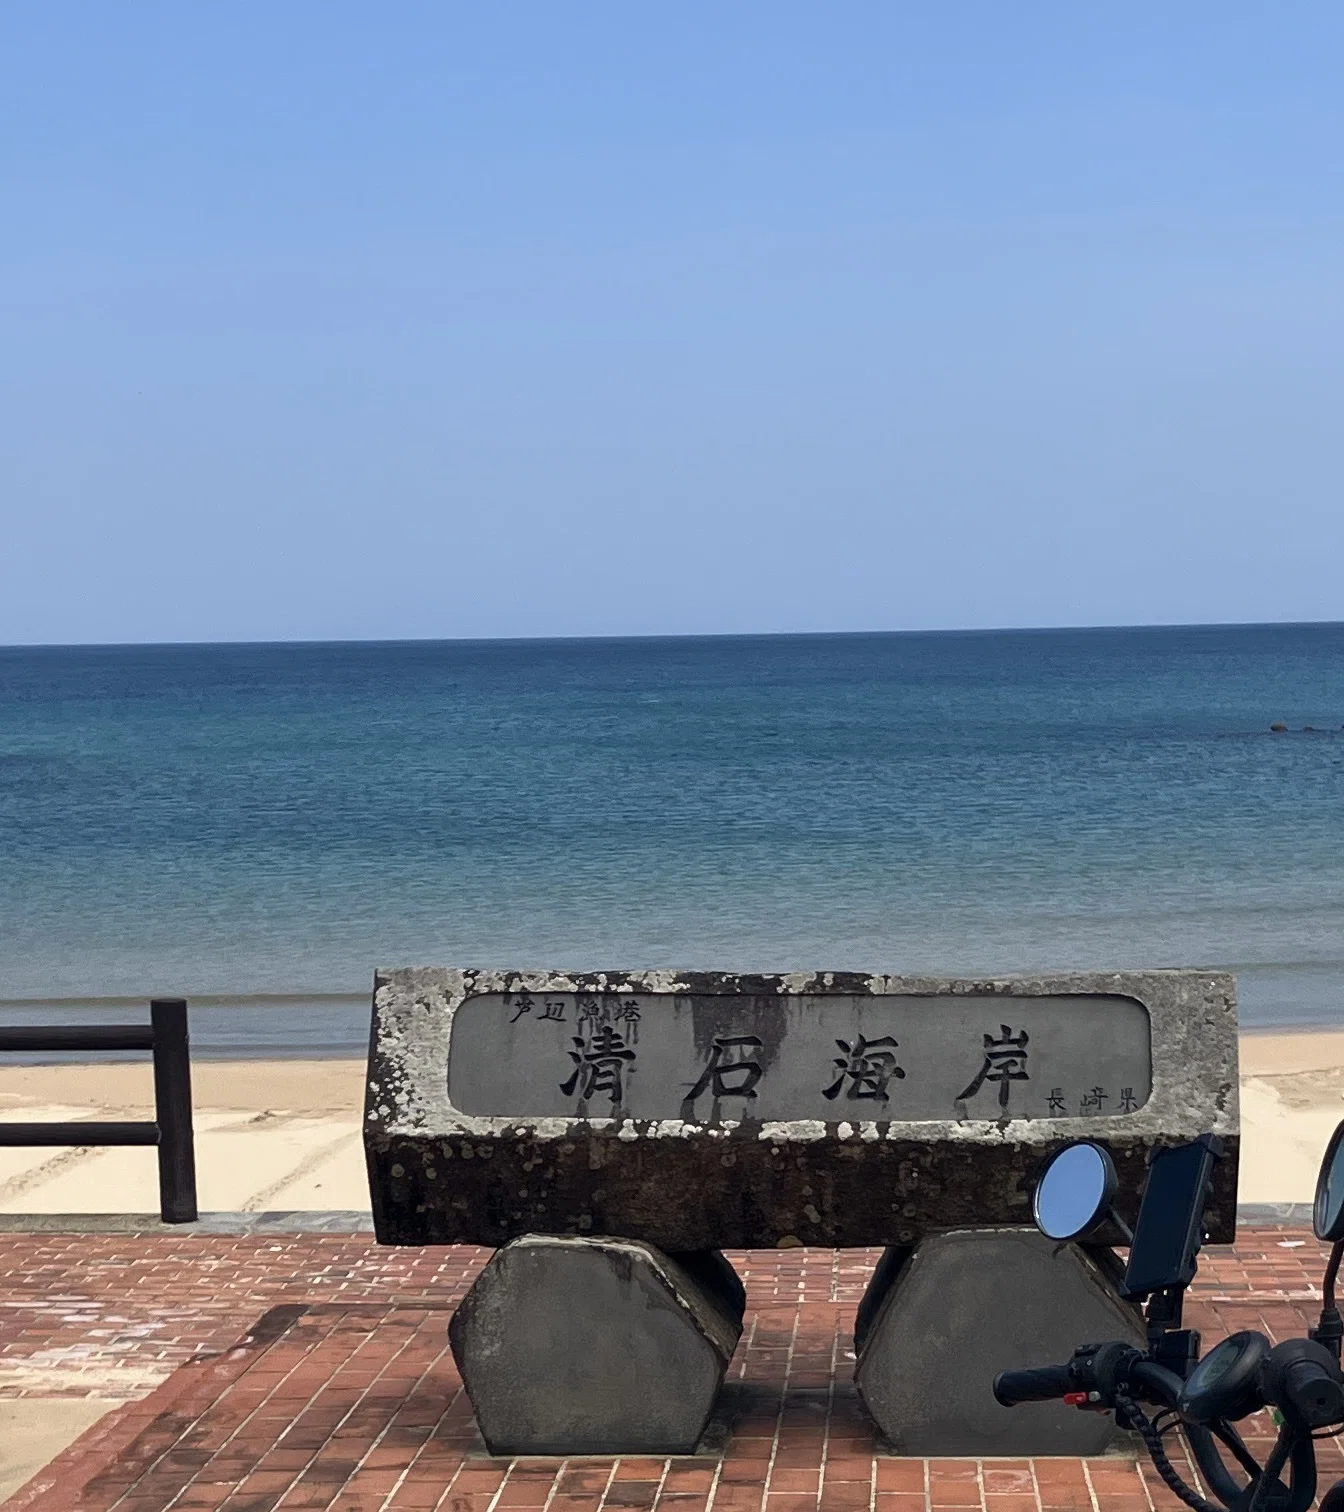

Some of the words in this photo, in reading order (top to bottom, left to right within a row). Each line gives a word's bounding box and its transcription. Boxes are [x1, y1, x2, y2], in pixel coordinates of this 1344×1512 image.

[509, 1000, 641, 1023] 芦辺漁港
[559, 1025, 1031, 1106] 清石海岸
[1045, 1086, 1139, 1110] 長崎県
